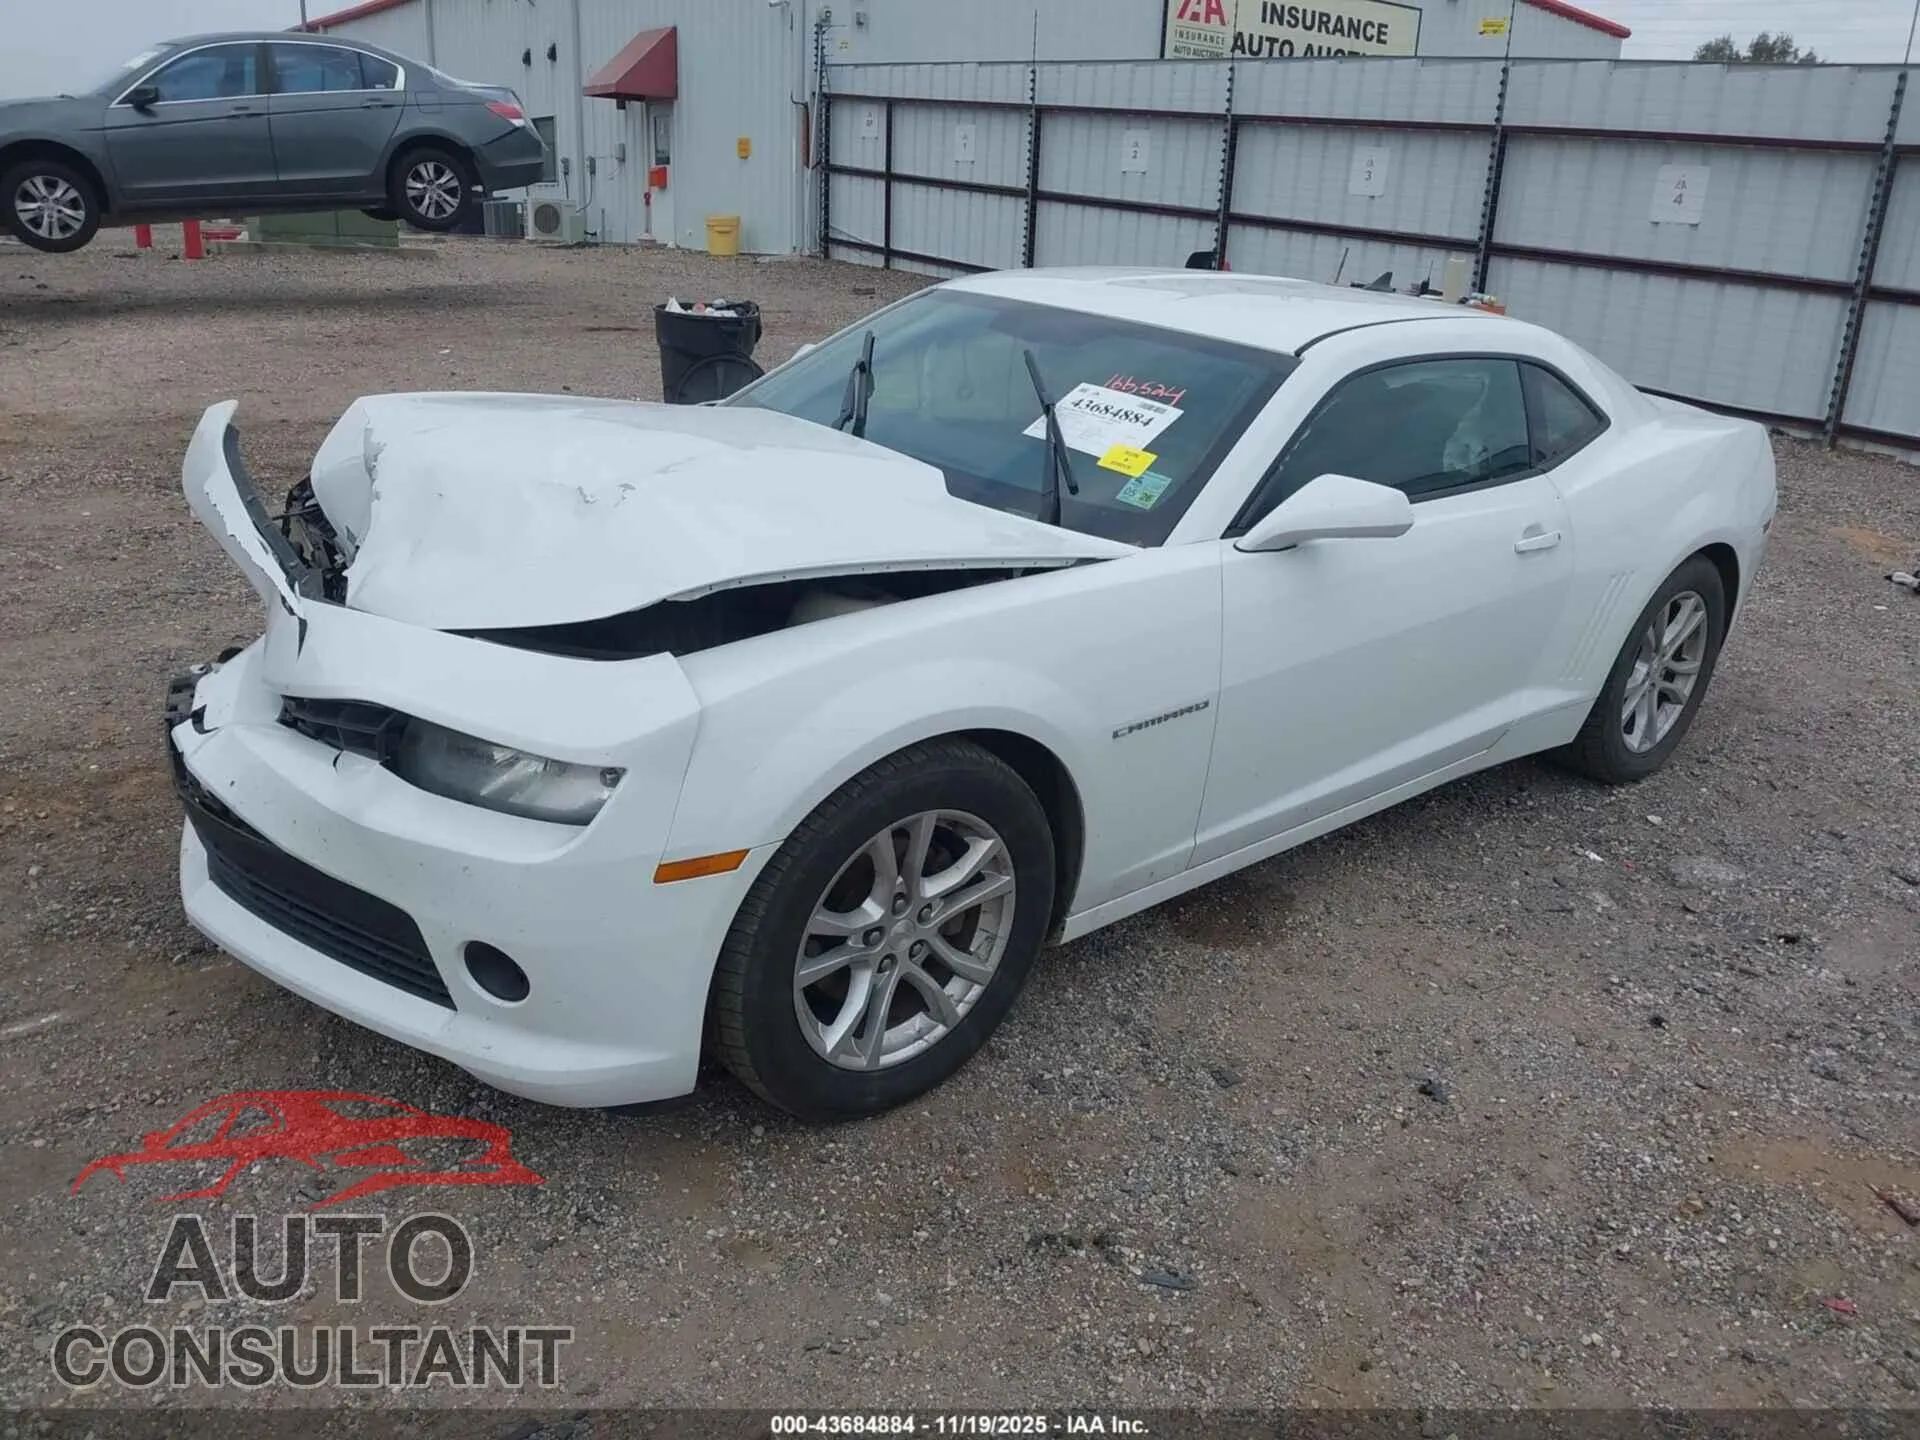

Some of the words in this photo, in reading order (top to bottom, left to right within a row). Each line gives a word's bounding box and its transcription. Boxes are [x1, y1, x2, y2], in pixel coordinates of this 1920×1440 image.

[1261, 1, 1389, 45] INSURANCE
[1174, 28, 1224, 45] INSURANCE
[1230, 31, 1295, 57] AUTO
[1363, 169, 1373, 181] 3
[1672, 192, 1684, 206] 4
[1071, 398, 1155, 428] 43684884
[1111, 699, 1210, 740] CAMARO
